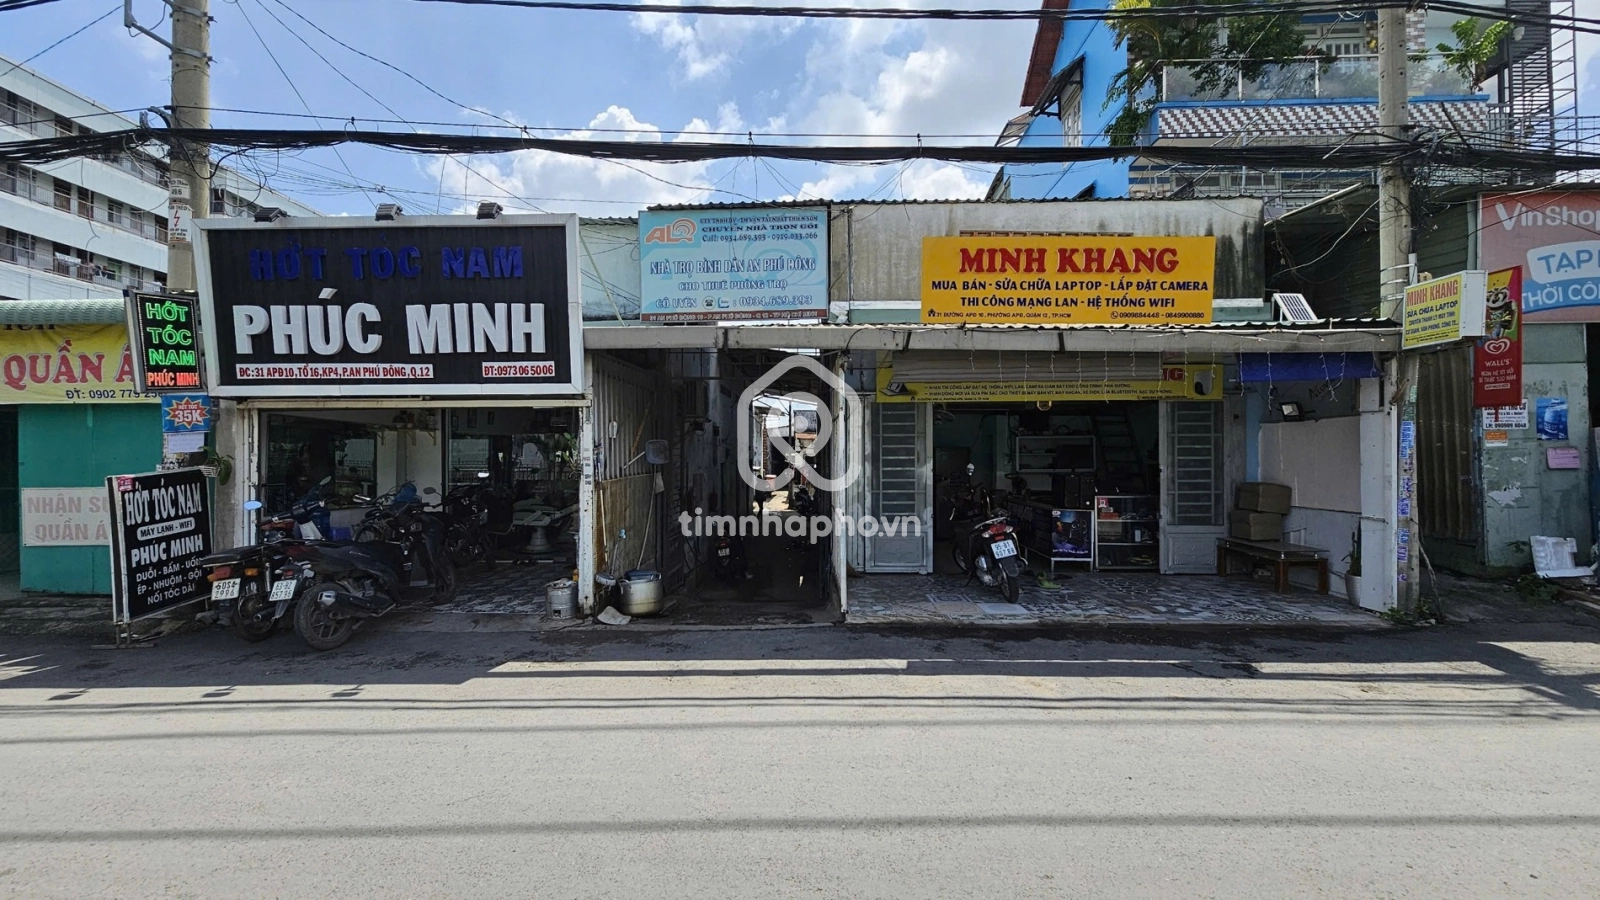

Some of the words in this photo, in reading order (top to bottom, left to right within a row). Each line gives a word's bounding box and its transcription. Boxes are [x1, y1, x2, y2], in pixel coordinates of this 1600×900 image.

[746, 223, 768, 231] NHÀ
[1495, 202, 1600, 231] VinSho
[441, 246, 524, 280] NAM
[650, 258, 671, 274] NHÀ
[672, 260, 694, 278] TRỌ
[696, 257, 722, 274] BÌNH
[747, 259, 761, 272] AN
[763, 255, 785, 272] PHÚ
[786, 255, 816, 271] ĐÔNG
[959, 248, 1047, 273] MINH
[1057, 248, 1179, 273] KHANG
[1537, 249, 1593, 274] TẠP
[678, 282, 700, 291] CHO
[702, 280, 728, 291] THUÊ
[730, 279, 765, 290] PHÒNG
[767, 279, 787, 291] TRỌ
[932, 281, 957, 290] MUA
[962, 278, 986, 290] BÁN
[995, 278, 1017, 290] SỬA
[1020, 278, 1051, 290] CHỮA
[1056, 281, 1102, 290] LAPTOP
[1110, 276, 1133, 290] LẮP
[1136, 279, 1158, 292] ĐẶT
[1160, 281, 1208, 291] CAMERA
[1407, 288, 1428, 307] MINH
[1430, 280, 1458, 301] KHANG
[1568, 281, 1600, 301] CÔ
[145, 300, 188, 322] HỚT
[960, 297, 978, 306] THI
[982, 294, 1014, 306] CÔNG
[1016, 298, 1052, 309] MẠNG
[1055, 298, 1078, 307] LAN
[1087, 295, 1102, 310] HỆ
[1105, 292, 1145, 308] THỐNG
[1149, 298, 1175, 307] WIFI
[232, 287, 383, 356] PHÚC
[405, 302, 546, 356] MINH
[146, 325, 192, 346] TÓC
[3, 338, 105, 391] QUẦN
[148, 348, 196, 366] NAM
[147, 368, 175, 386] PHÚC
[176, 372, 199, 386] MINH
[363, 364, 380, 377] PHÚ
[89, 390, 116, 399] 0902
[175, 410, 202, 422] 35K
[28, 493, 81, 517] NHẬN
[124, 481, 150, 526] HỚT
[152, 478, 175, 520] TÓC
[176, 482, 202, 516] NAM
[35, 518, 88, 542] QUẦN
[140, 525, 156, 537] MÁY
[157, 525, 174, 536] LẠNH
[180, 520, 193, 529] WIFI
[131, 540, 167, 568] PHÚC
[171, 534, 204, 558] MINH
[163, 560, 180, 574] BẤM
[137, 583, 146, 595] ÉP
[153, 574, 182, 590] NHUỘM
[147, 591, 162, 605] NỐI
[164, 586, 180, 600] TÓC
